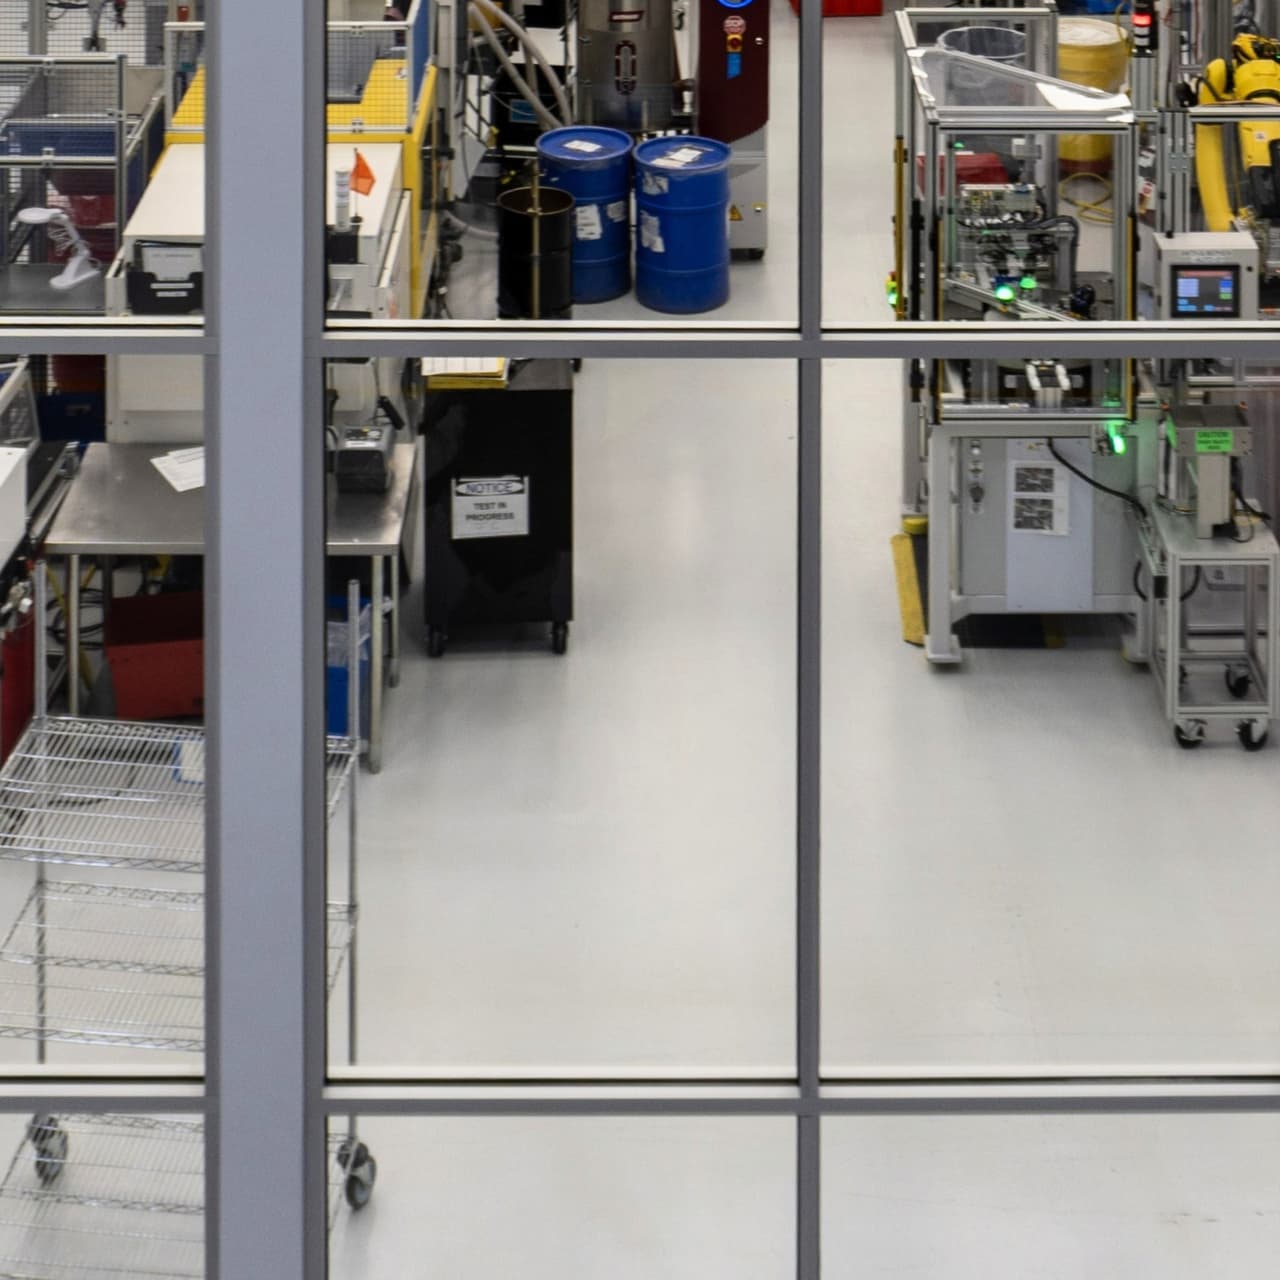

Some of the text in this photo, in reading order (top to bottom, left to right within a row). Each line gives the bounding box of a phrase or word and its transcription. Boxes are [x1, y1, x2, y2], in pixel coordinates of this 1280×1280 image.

[465, 482, 512, 493] NOTICE
[473, 501, 508, 511] TEST IN
[465, 512, 515, 521] PROGRESS
